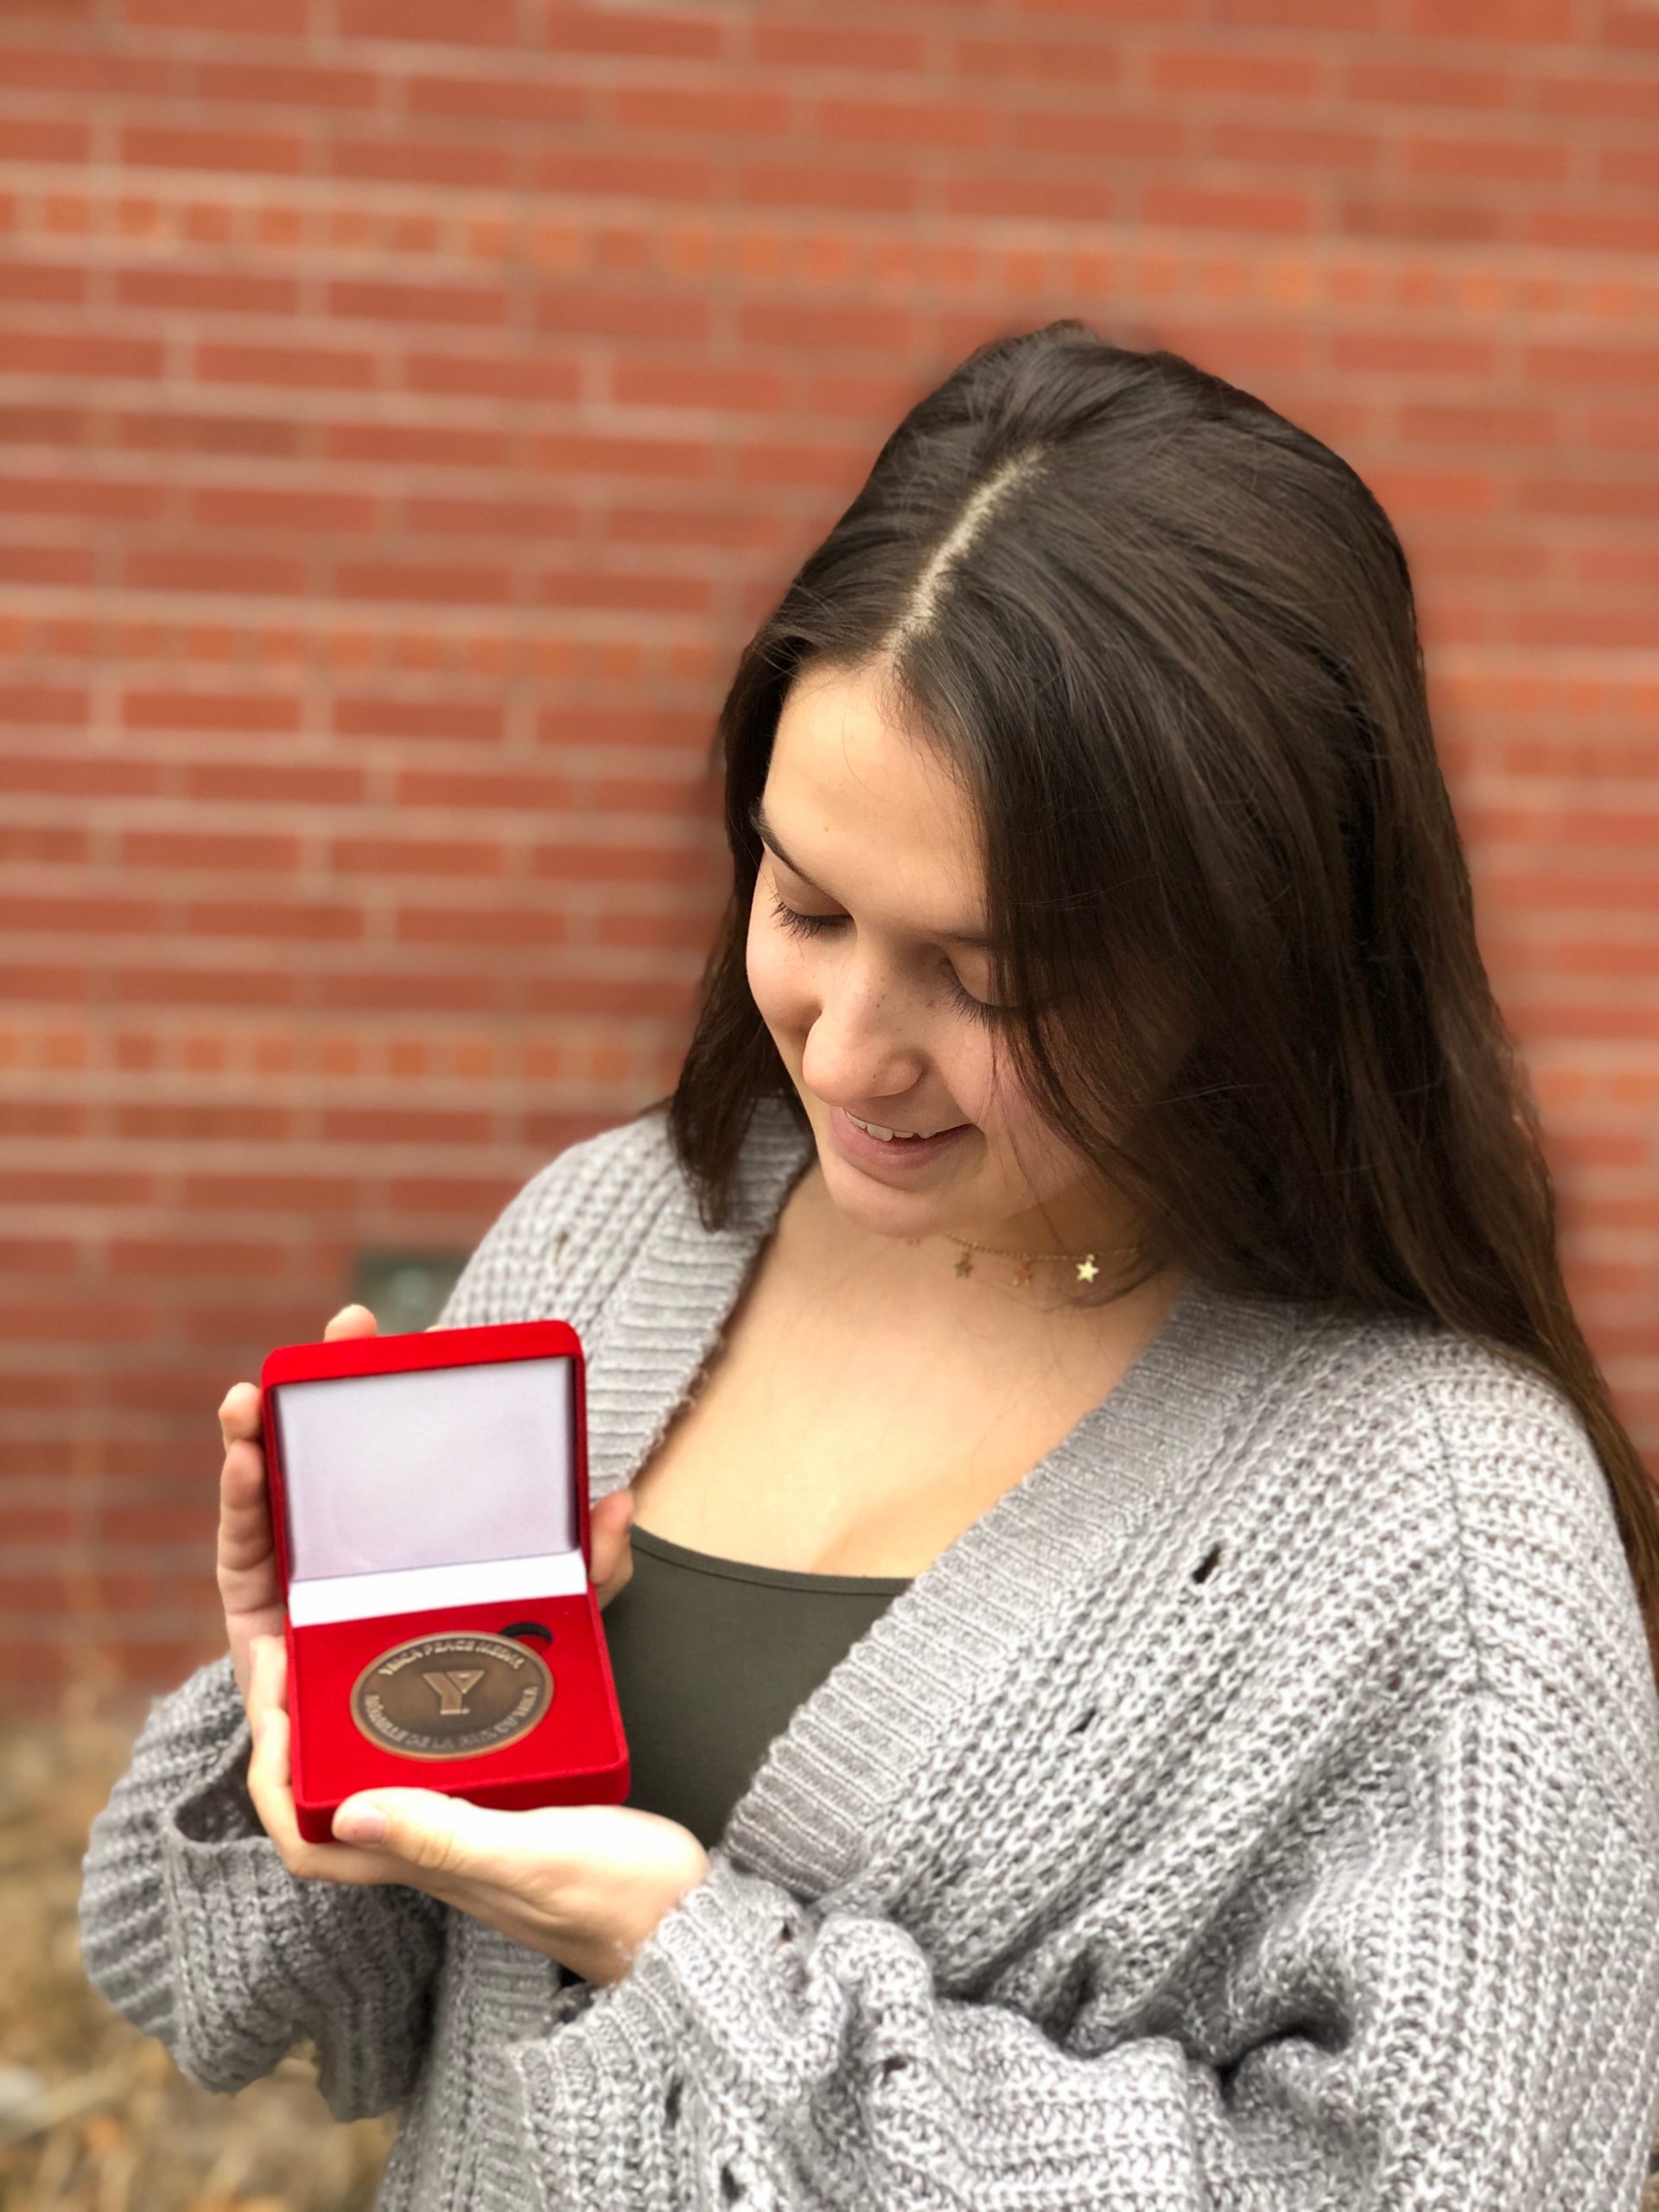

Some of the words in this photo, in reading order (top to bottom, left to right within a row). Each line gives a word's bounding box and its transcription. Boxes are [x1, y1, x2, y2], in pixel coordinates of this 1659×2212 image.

[424, 1639, 475, 1656] PEACE
[475, 1641, 524, 1670] MEDAL
[431, 1737, 455, 1751] LA
